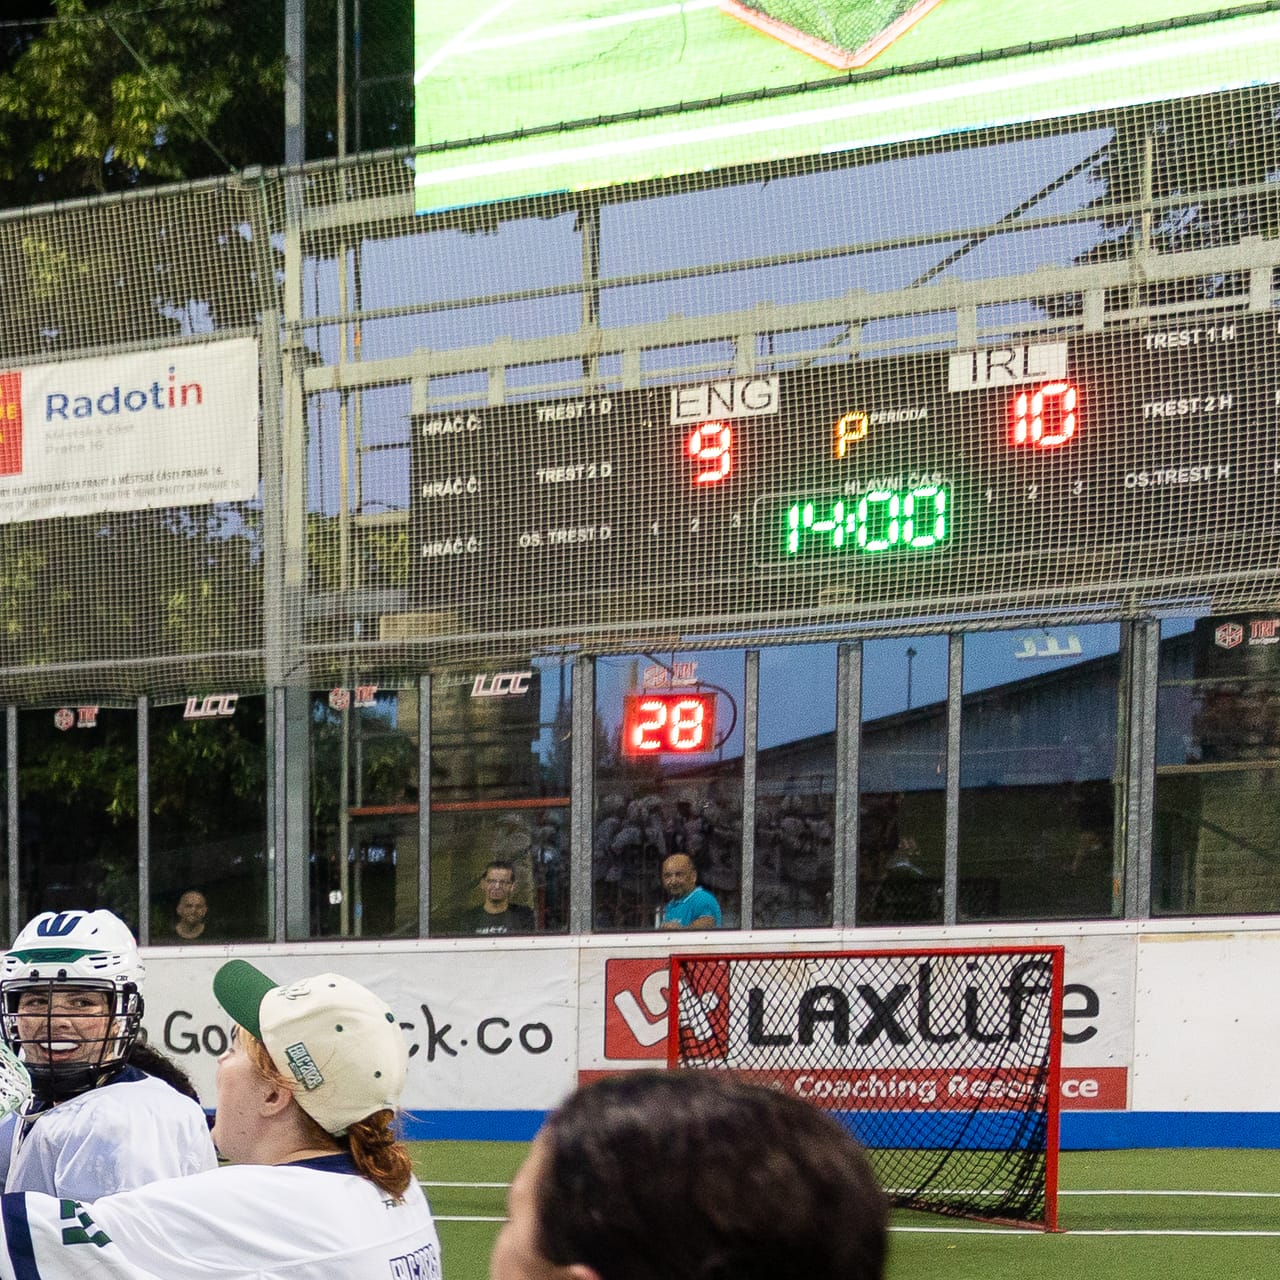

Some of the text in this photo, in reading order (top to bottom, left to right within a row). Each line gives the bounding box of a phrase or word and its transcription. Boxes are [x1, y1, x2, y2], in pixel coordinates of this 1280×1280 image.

[1144, 329, 1201, 350] TREST
[1221, 326, 1234, 341] H
[972, 346, 1046, 385] IRL
[677, 378, 771, 418] ENG
[1143, 394, 1232, 418] TREST 2 H
[538, 402, 585, 423] TREST
[601, 399, 612, 415] D
[870, 408, 927, 424] PERIODA
[1012, 383, 1077, 444] 10
[837, 412, 868, 457] P
[690, 423, 730, 483] 9
[538, 463, 612, 483] TREST 2 D
[1217, 464, 1230, 479] H
[1029, 485, 1038, 499] 2
[1074, 481, 1083, 495] 3
[691, 518, 700, 532] 2
[788, 486, 946, 553] 14:00
[549, 528, 594, 545] TREST
[600, 527, 611, 540] D
[470, 672, 531, 697] LCC
[183, 693, 239, 719] LCC
[632, 700, 704, 750] 28
[794, 1075, 938, 1103] Coaching
[948, 1075, 1099, 1099] Resouce
